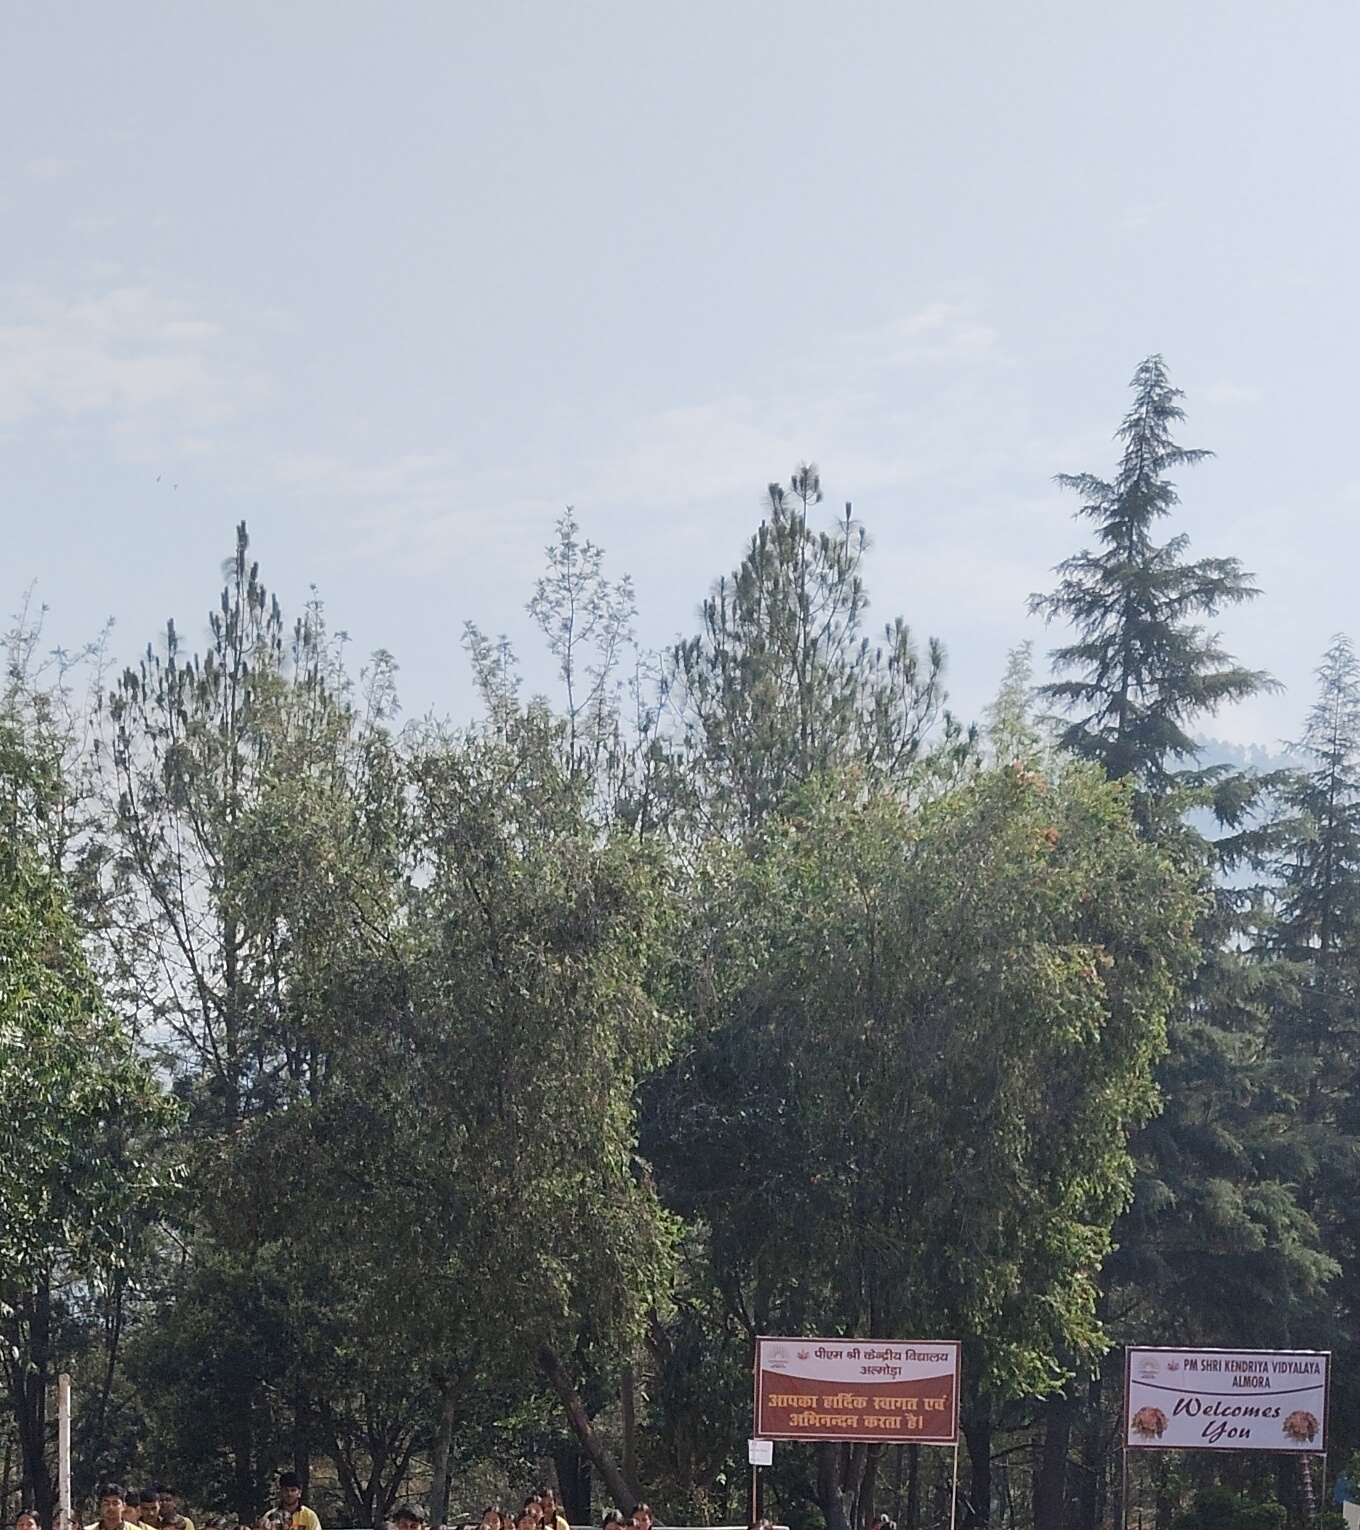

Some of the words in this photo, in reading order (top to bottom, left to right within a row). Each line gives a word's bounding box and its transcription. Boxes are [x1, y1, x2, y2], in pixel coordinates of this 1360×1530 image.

[814, 1347, 843, 1361] पीएम
[846, 1348, 860, 1360] श्री
[864, 1348, 902, 1363] केन्द्रीय
[905, 1348, 949, 1363] विद्यालय
[859, 1364, 902, 1379] अल्मोड़ा
[1183, 1359, 1198, 1372] PM
[1200, 1359, 1222, 1373] SHRI
[1224, 1359, 1269, 1374] KENDRIYA
[1272, 1361, 1321, 1375] VIDYALAYA
[1232, 1375, 1271, 1389] ALMORA
[768, 1393, 818, 1408] आपका
[823, 1392, 868, 1409] हार्दिक
[873, 1396, 919, 1411] स्वागत
[924, 1394, 948, 1412] एवं
[1172, 1398, 1282, 1419] Welcomes
[789, 1411, 859, 1428] अभिनन्दन
[863, 1414, 903, 1430] करता
[1201, 1420, 1251, 1444] You
